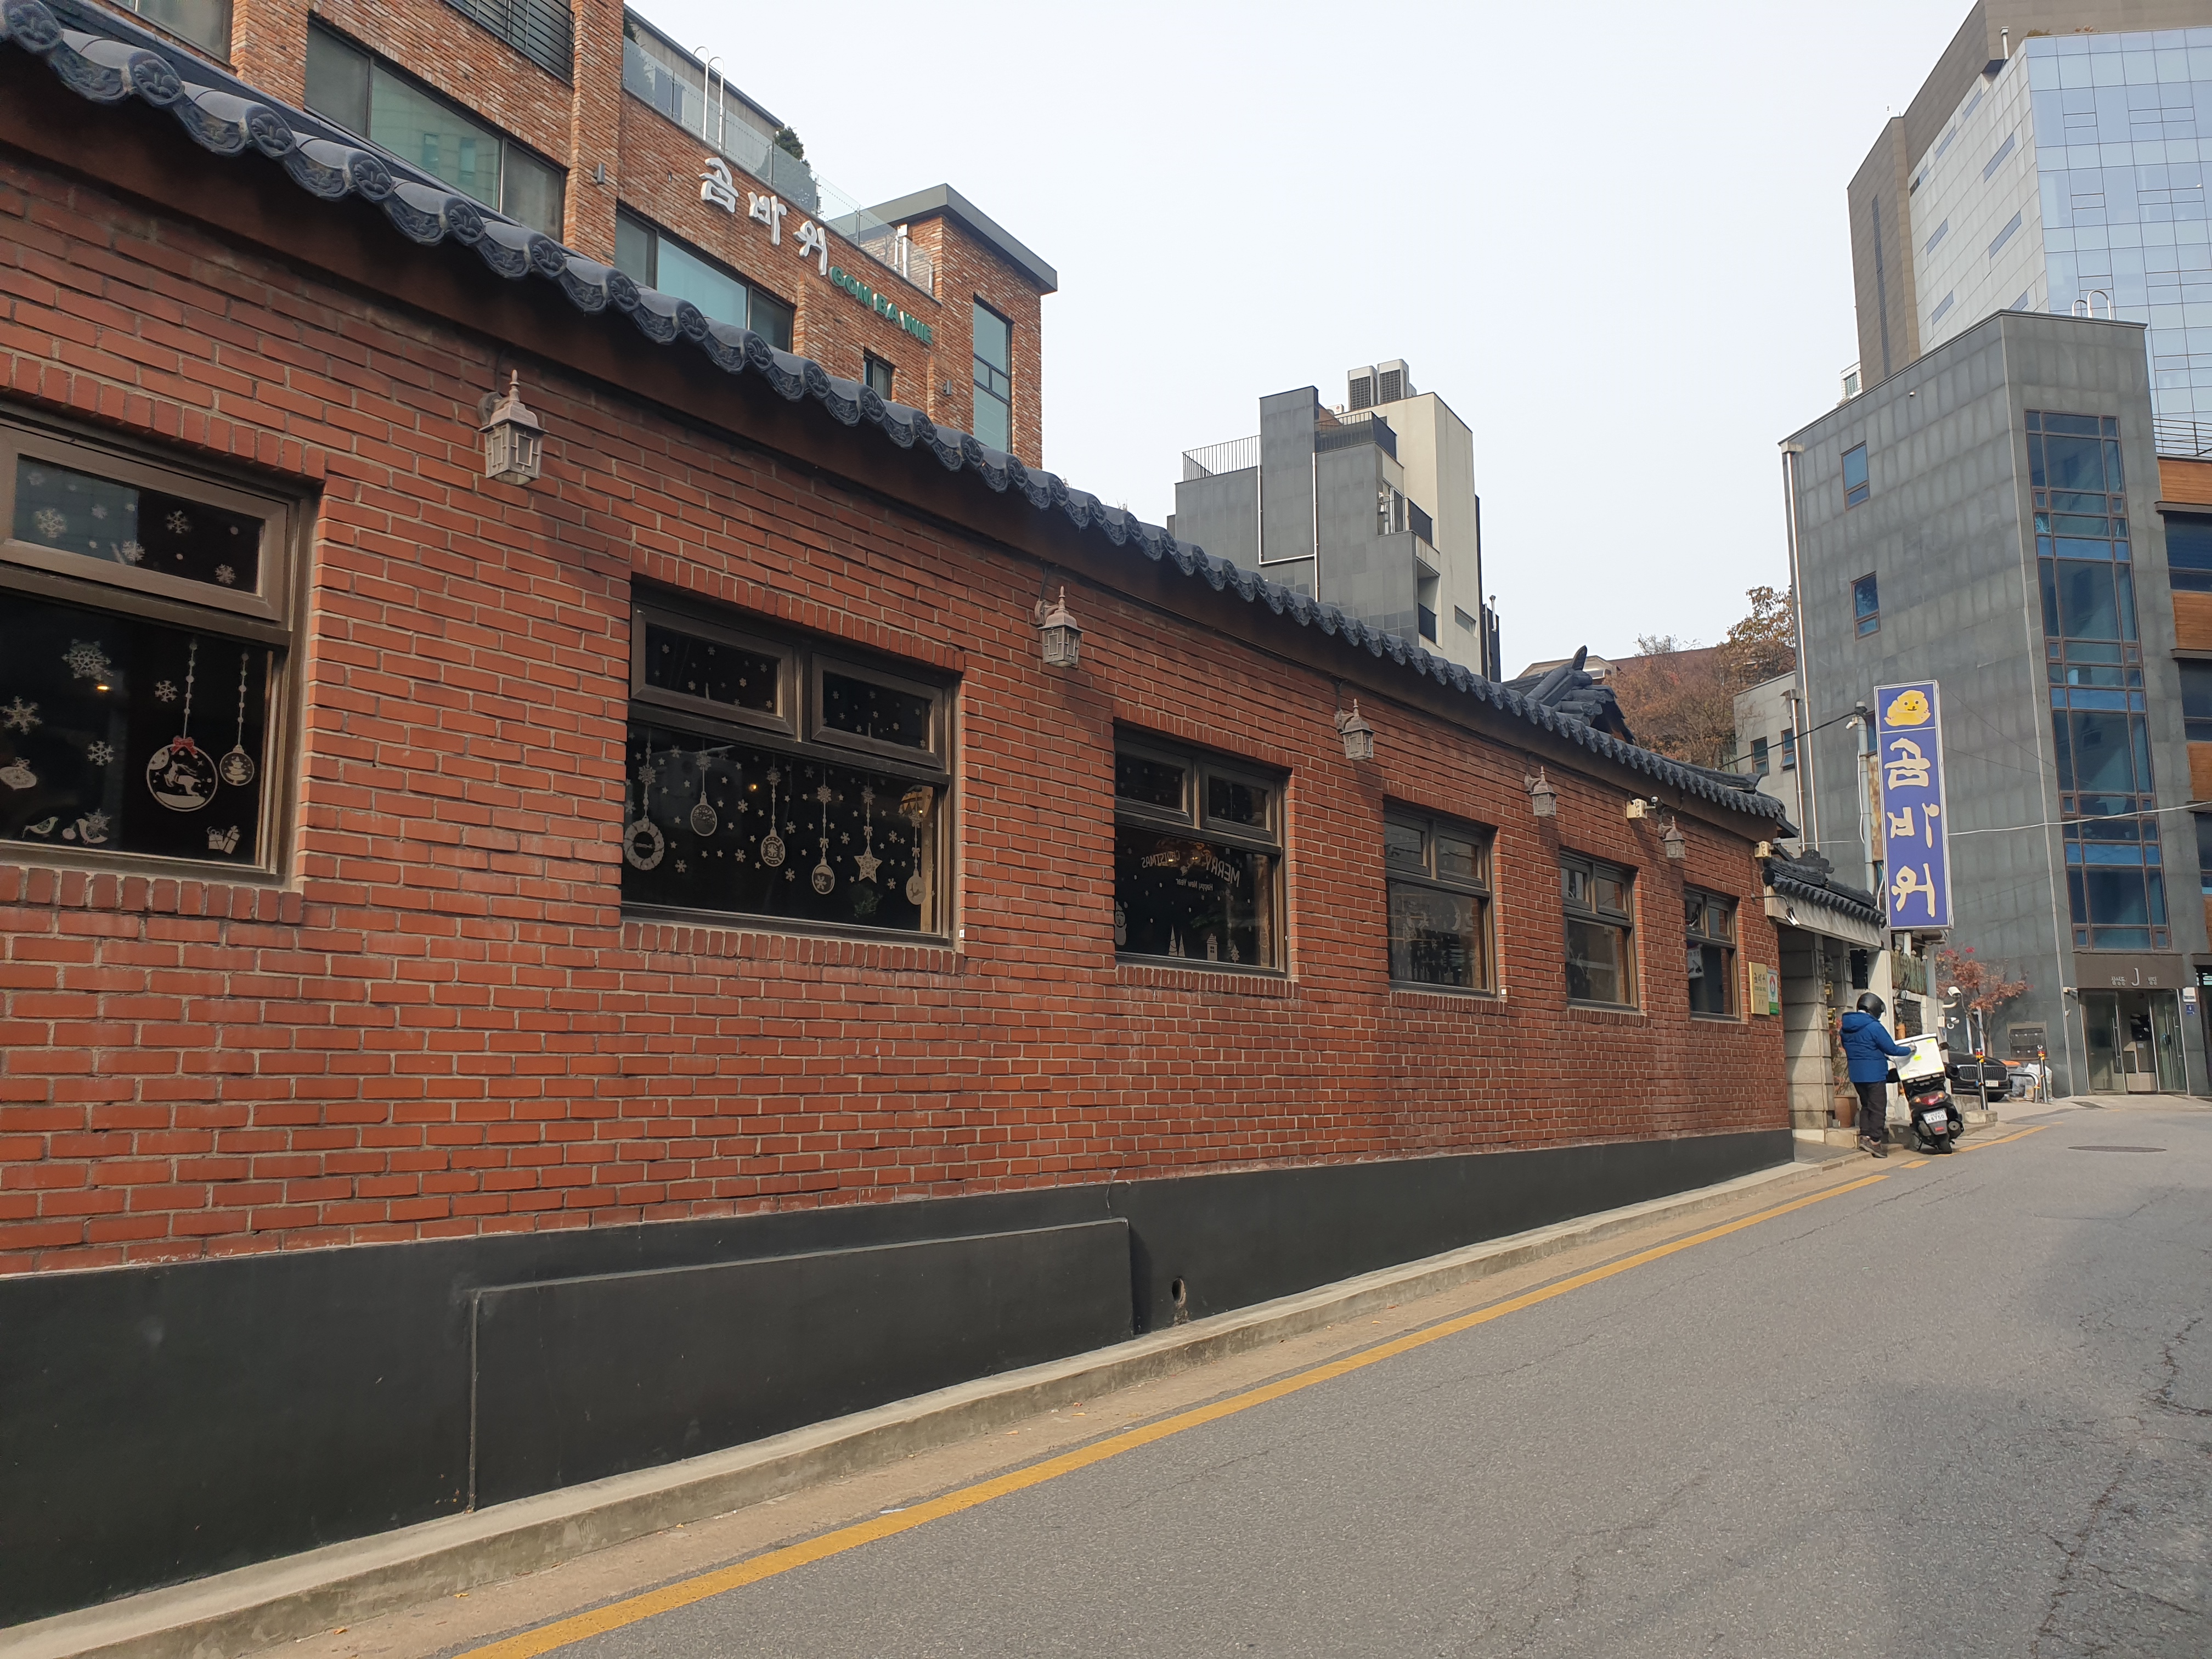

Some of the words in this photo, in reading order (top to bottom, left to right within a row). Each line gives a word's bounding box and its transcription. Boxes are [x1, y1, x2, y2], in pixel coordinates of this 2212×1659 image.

[699, 157, 827, 275] 곰바위
[828, 266, 872, 306] GOM
[1884, 737, 1940, 918] 곰바위
[2131, 968, 2140, 986] J
